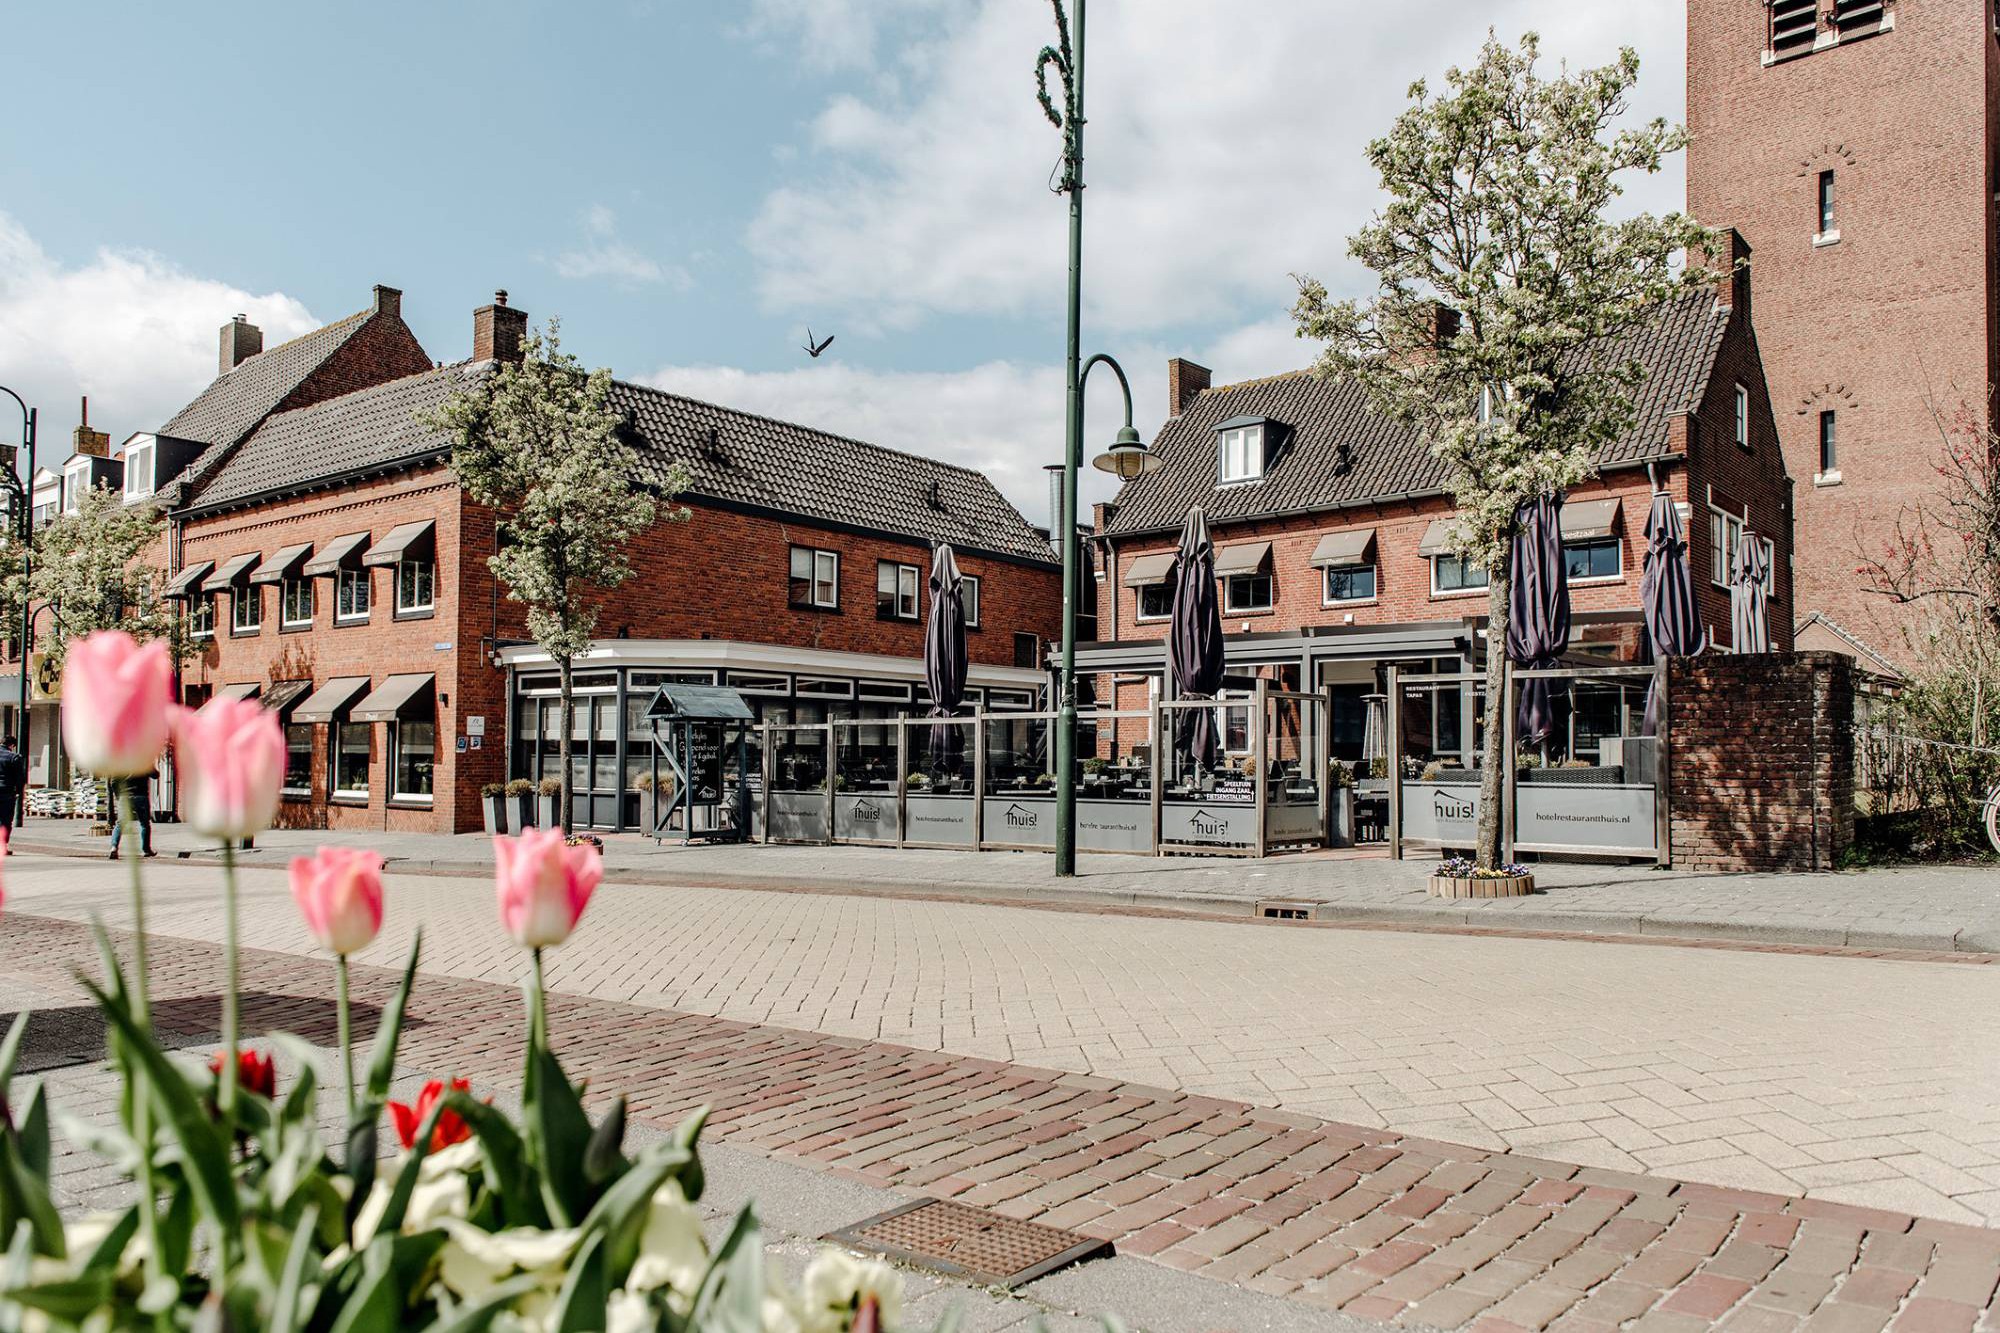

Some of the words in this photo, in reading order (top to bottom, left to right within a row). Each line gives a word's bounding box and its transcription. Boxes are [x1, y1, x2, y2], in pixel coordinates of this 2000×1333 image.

[854, 807, 880, 820] Thuis!
[1007, 812, 1037, 826] Thuis!
[1535, 812, 1630, 824] hotelrestaurantthuis.nl
